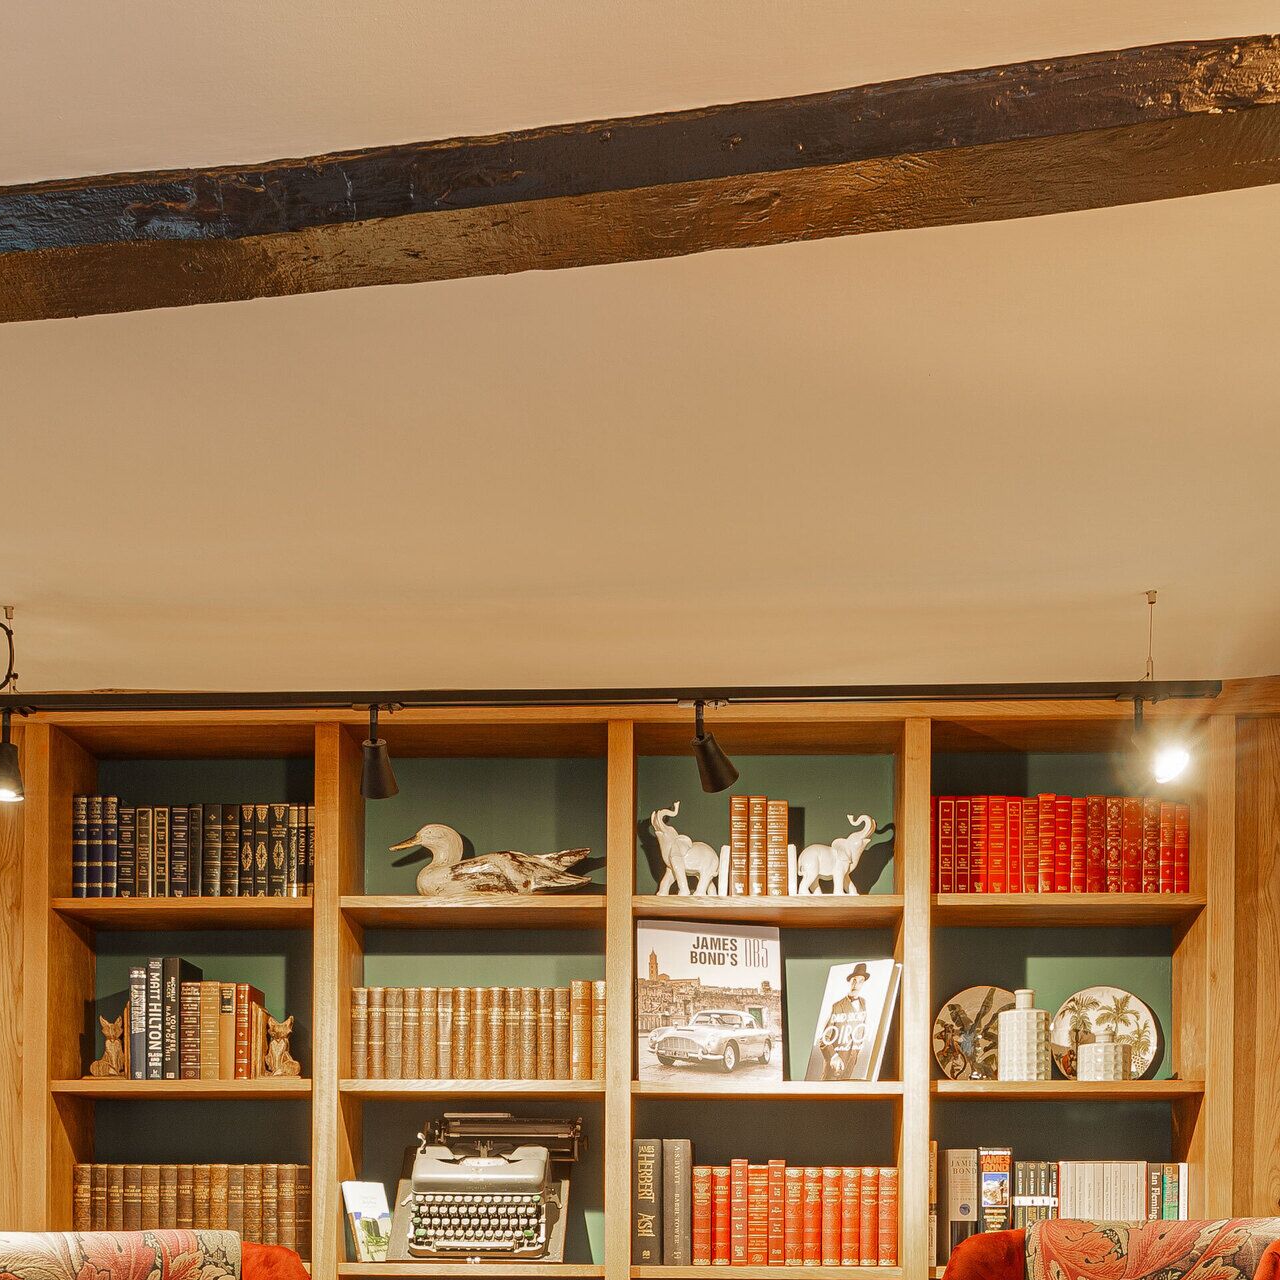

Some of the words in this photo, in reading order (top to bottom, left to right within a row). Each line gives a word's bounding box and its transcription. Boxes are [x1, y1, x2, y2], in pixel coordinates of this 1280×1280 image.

[692, 936, 738, 952] JAMES
[690, 951, 738, 967] BOND'S
[149, 972, 160, 1000] MATT
[131, 985, 145, 1034] LUSITANIA
[148, 1003, 162, 1050] HILTON
[981, 1156, 1010, 1164] JAMES
[983, 1163, 1009, 1172] BOND
[637, 1152, 656, 1203] HERBERT
[1151, 1171, 1160, 1185] Ian
[1149, 1187, 1160, 1220] Fleming
[637, 1212, 656, 1237] ASH
